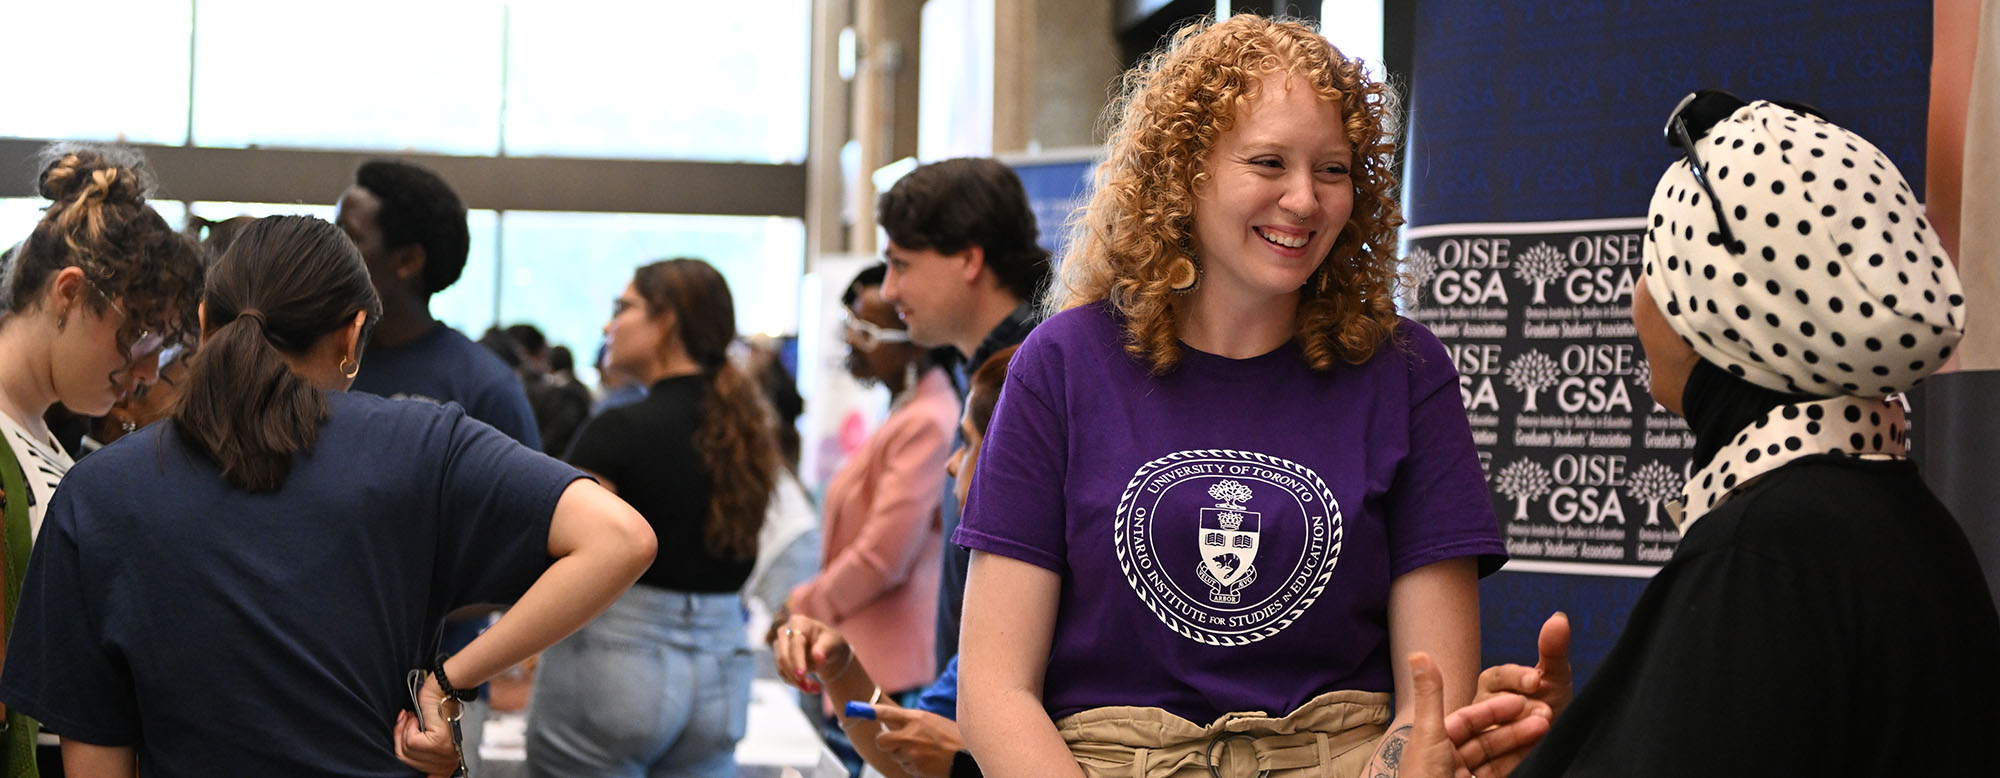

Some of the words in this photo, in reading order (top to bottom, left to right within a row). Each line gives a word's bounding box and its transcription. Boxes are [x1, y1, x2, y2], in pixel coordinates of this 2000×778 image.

[1438, 238, 1511, 270] OISE
[1569, 234, 1641, 267] OISE
[1433, 270, 1508, 304] GSA
[1565, 267, 1635, 304] GSA
[1449, 344, 1501, 375] ISE
[1561, 344, 1634, 376] OISE
[1460, 375, 1499, 412] SA
[1557, 376, 1632, 413] GSA
[1515, 428, 1552, 448] Graduate
[1589, 429, 1632, 449] Association
[1147, 464, 1225, 494] UNIVERSITY
[1229, 465, 1249, 475] OF
[1253, 467, 1313, 503] TORONTO
[1553, 453, 1627, 486] OISE
[1548, 486, 1625, 524] GSA
[1507, 537, 1544, 556] Graduate
[1581, 540, 1624, 560] Association
[1133, 507, 1151, 569] ONTARIO
[1148, 570, 1207, 623] INSTITUTE
[1210, 616, 1226, 625] FOR
[1229, 600, 1283, 627] STUDIES
[1282, 591, 1293, 602] IN
[1292, 515, 1324, 593] EDUCATION
